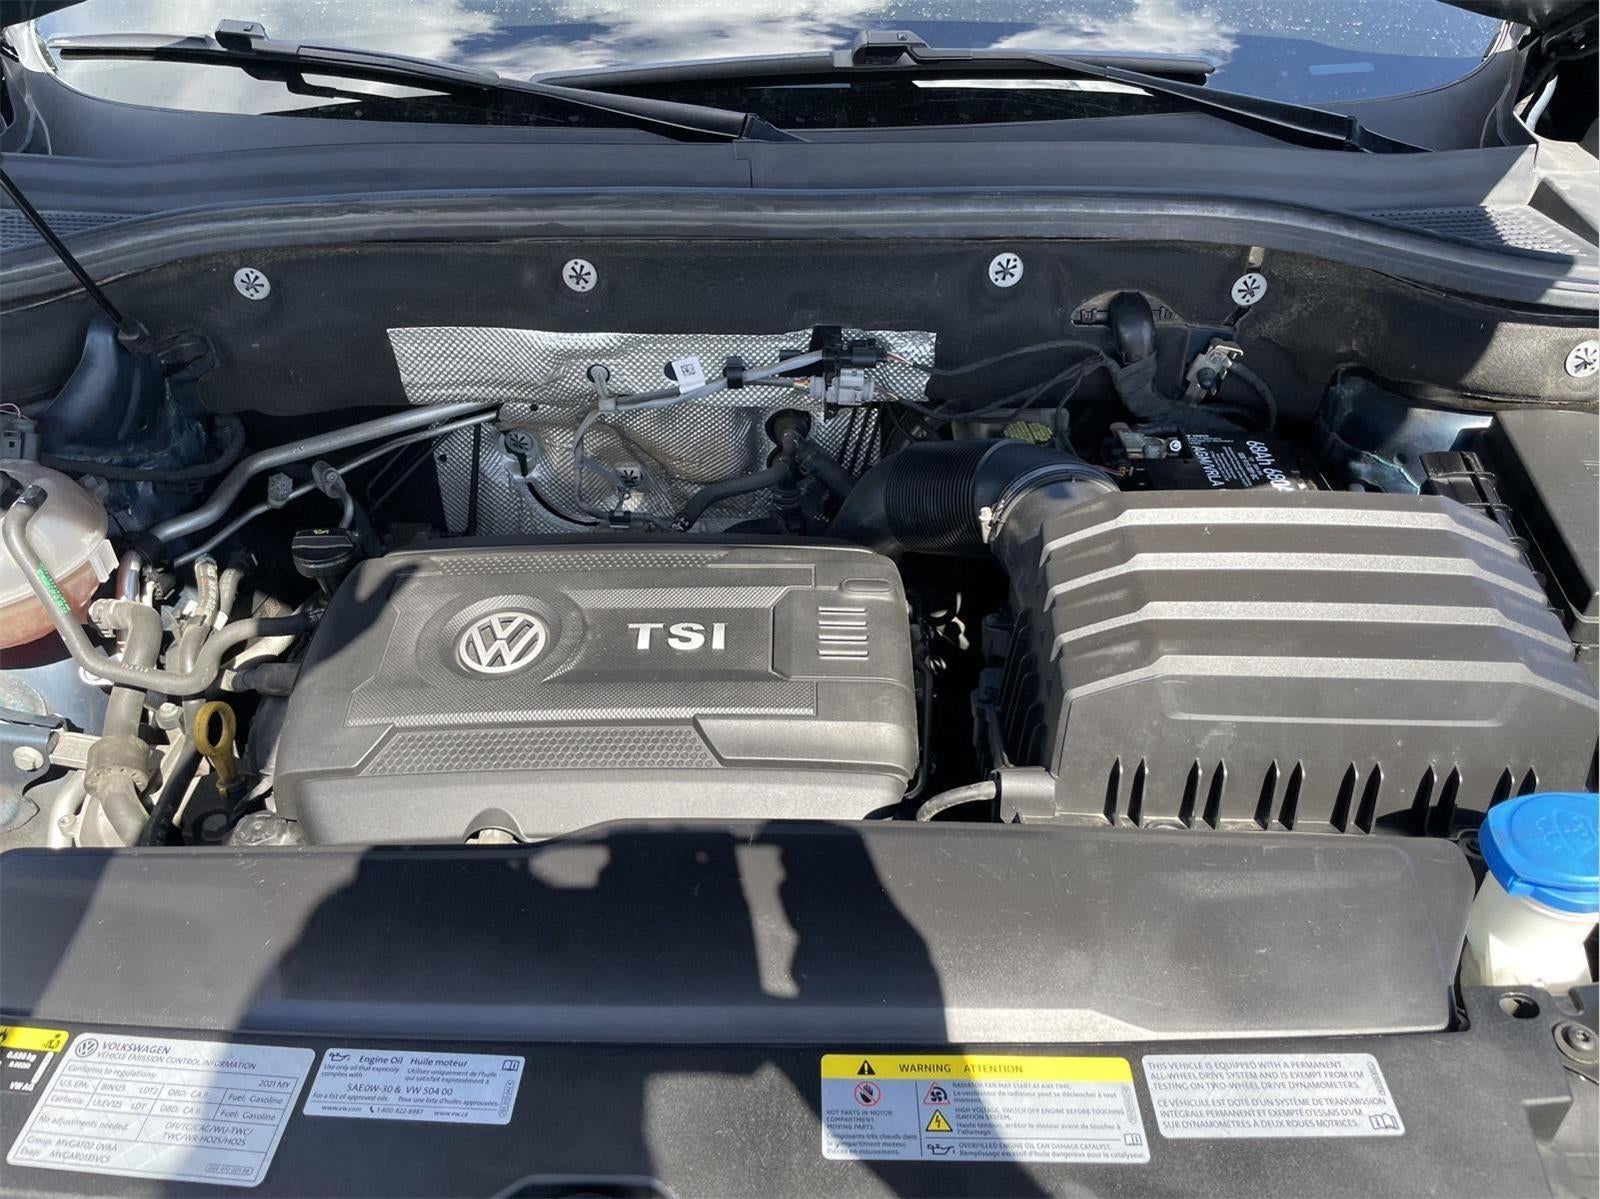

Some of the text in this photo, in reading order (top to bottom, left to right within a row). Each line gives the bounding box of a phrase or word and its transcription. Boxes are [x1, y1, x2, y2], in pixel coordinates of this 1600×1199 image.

[1246, 440, 1275, 465] 68Ah
[1191, 446, 1225, 487] AGM/VRLA
[628, 622, 726, 651] TSI
[103, 1041, 171, 1055] VOLKSWAGEN
[97, 1051, 257, 1070] VEHICLE EMISSION CONTROL INFORMATION
[359, 1056, 404, 1065] Engine Oil
[68, 1065, 102, 1075] Conforms
[899, 1064, 1023, 1073] WARNING ATTENTION
[1147, 1061, 1342, 1070] THIS VEHICLE IS EQUIPPED WITH A PERMANENT
[1150, 1072, 1197, 1080] ALL-WHEEL
[1199, 1072, 1224, 1080] DRIVE
[1226, 1072, 1257, 1080] SYSTEM
[1259, 1071, 1278, 1079] AND
[1280, 1071, 1288, 1079] IS
[1290, 1071, 1322, 1079] EXEMPT
[1324, 1071, 1348, 1079] FROM
[259, 1080, 276, 1088] 2021
[1261, 1081, 1287, 1089] DRIVE
[190, 1090, 202, 1099] CA
[347, 1084, 454, 1096] SAE0W-30 & VW 504 00
[250, 1095, 283, 1105] Gasoline
[1157, 1099, 1167, 1107] CE
[1251, 1098, 1274, 1106] D'UN
[131, 1102, 146, 1110] LDT
[183, 1106, 194, 1115] CA
[243, 1112, 276, 1122] Gasoline
[1206, 1109, 1256, 1117] PERMANENT
[1257, 1109, 1268, 1117] ET
[39, 1114, 50, 1122] No
[51, 1117, 98, 1128] adjustments
[1163, 1119, 1181, 1128] SUR
[1262, 1119, 1287, 1128] DEUX
[1288, 1119, 1315, 1128] ROUES
